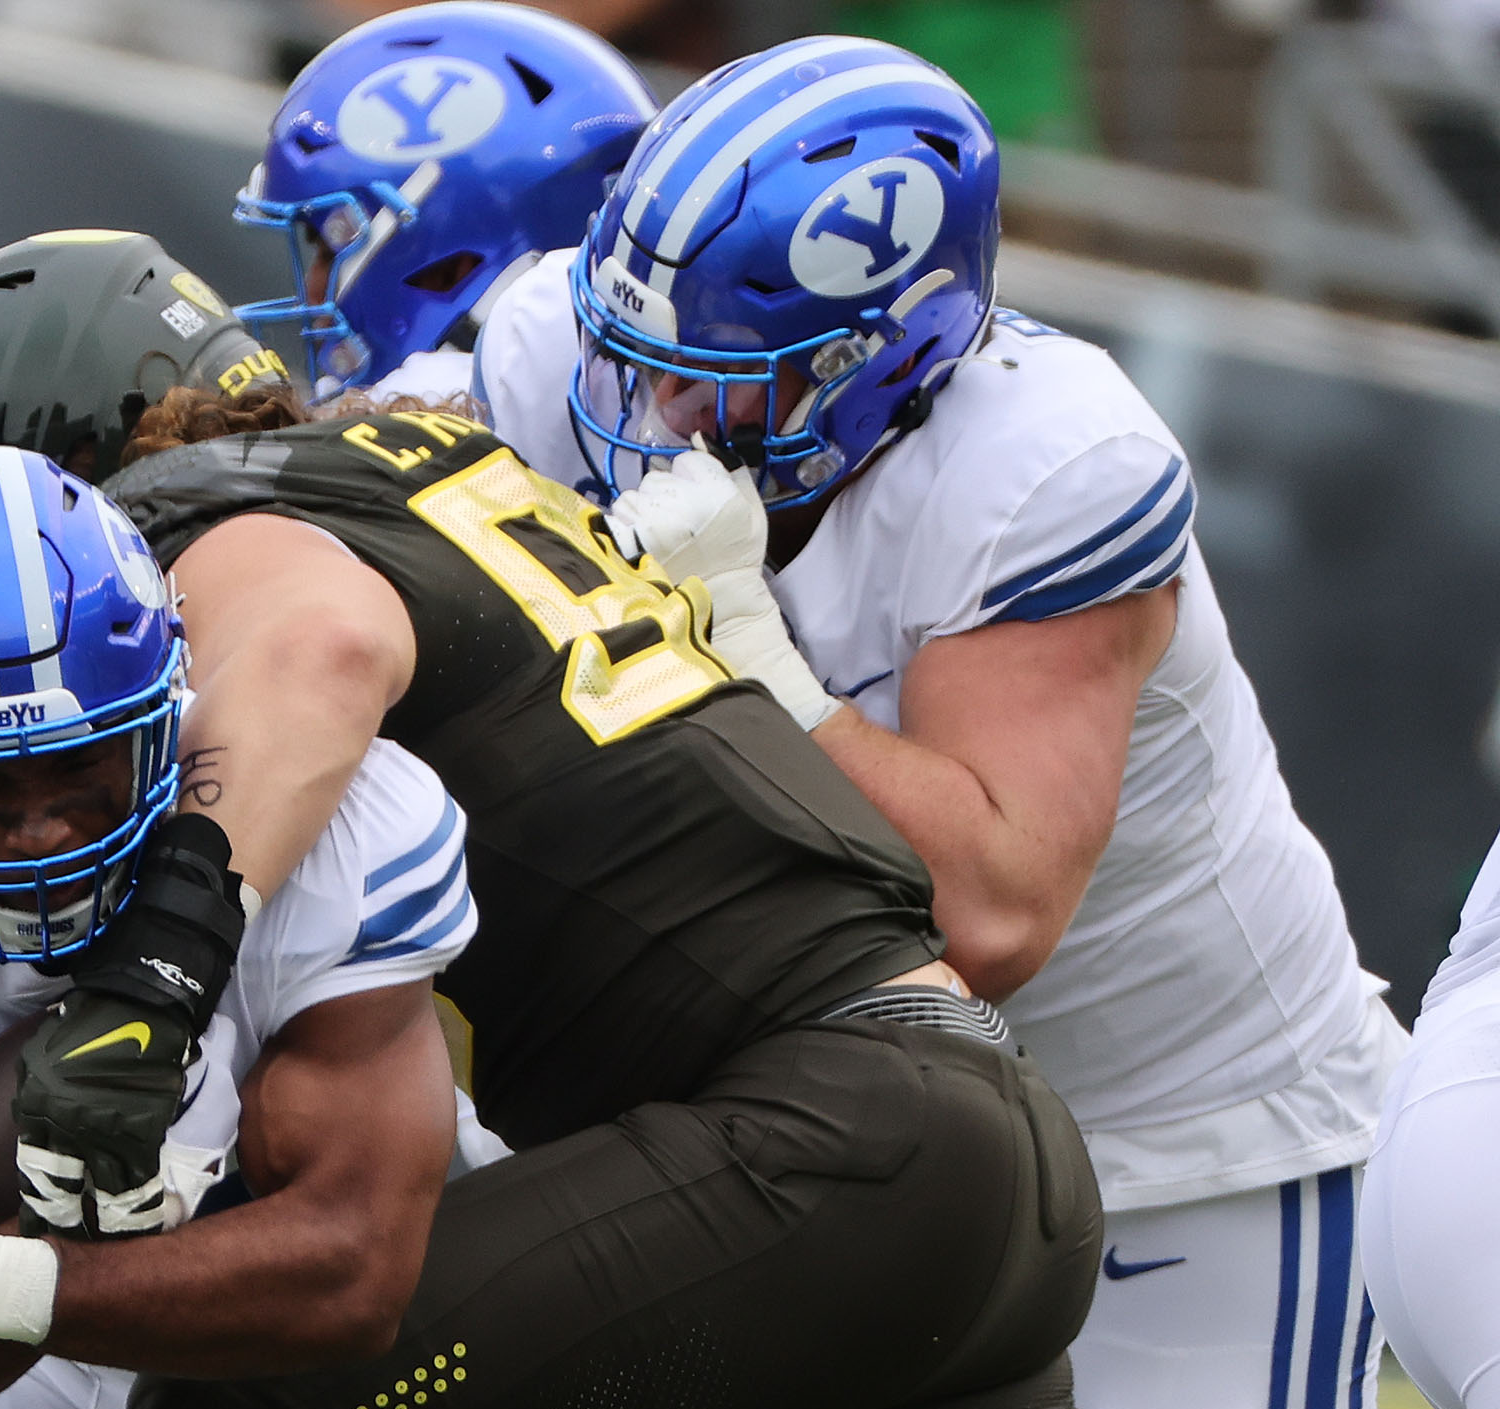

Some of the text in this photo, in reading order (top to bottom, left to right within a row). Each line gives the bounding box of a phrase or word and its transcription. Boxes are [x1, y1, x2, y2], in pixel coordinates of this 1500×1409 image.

[362, 69, 475, 148] Y
[806, 170, 908, 278] Y
[612, 277, 644, 313] BYU
